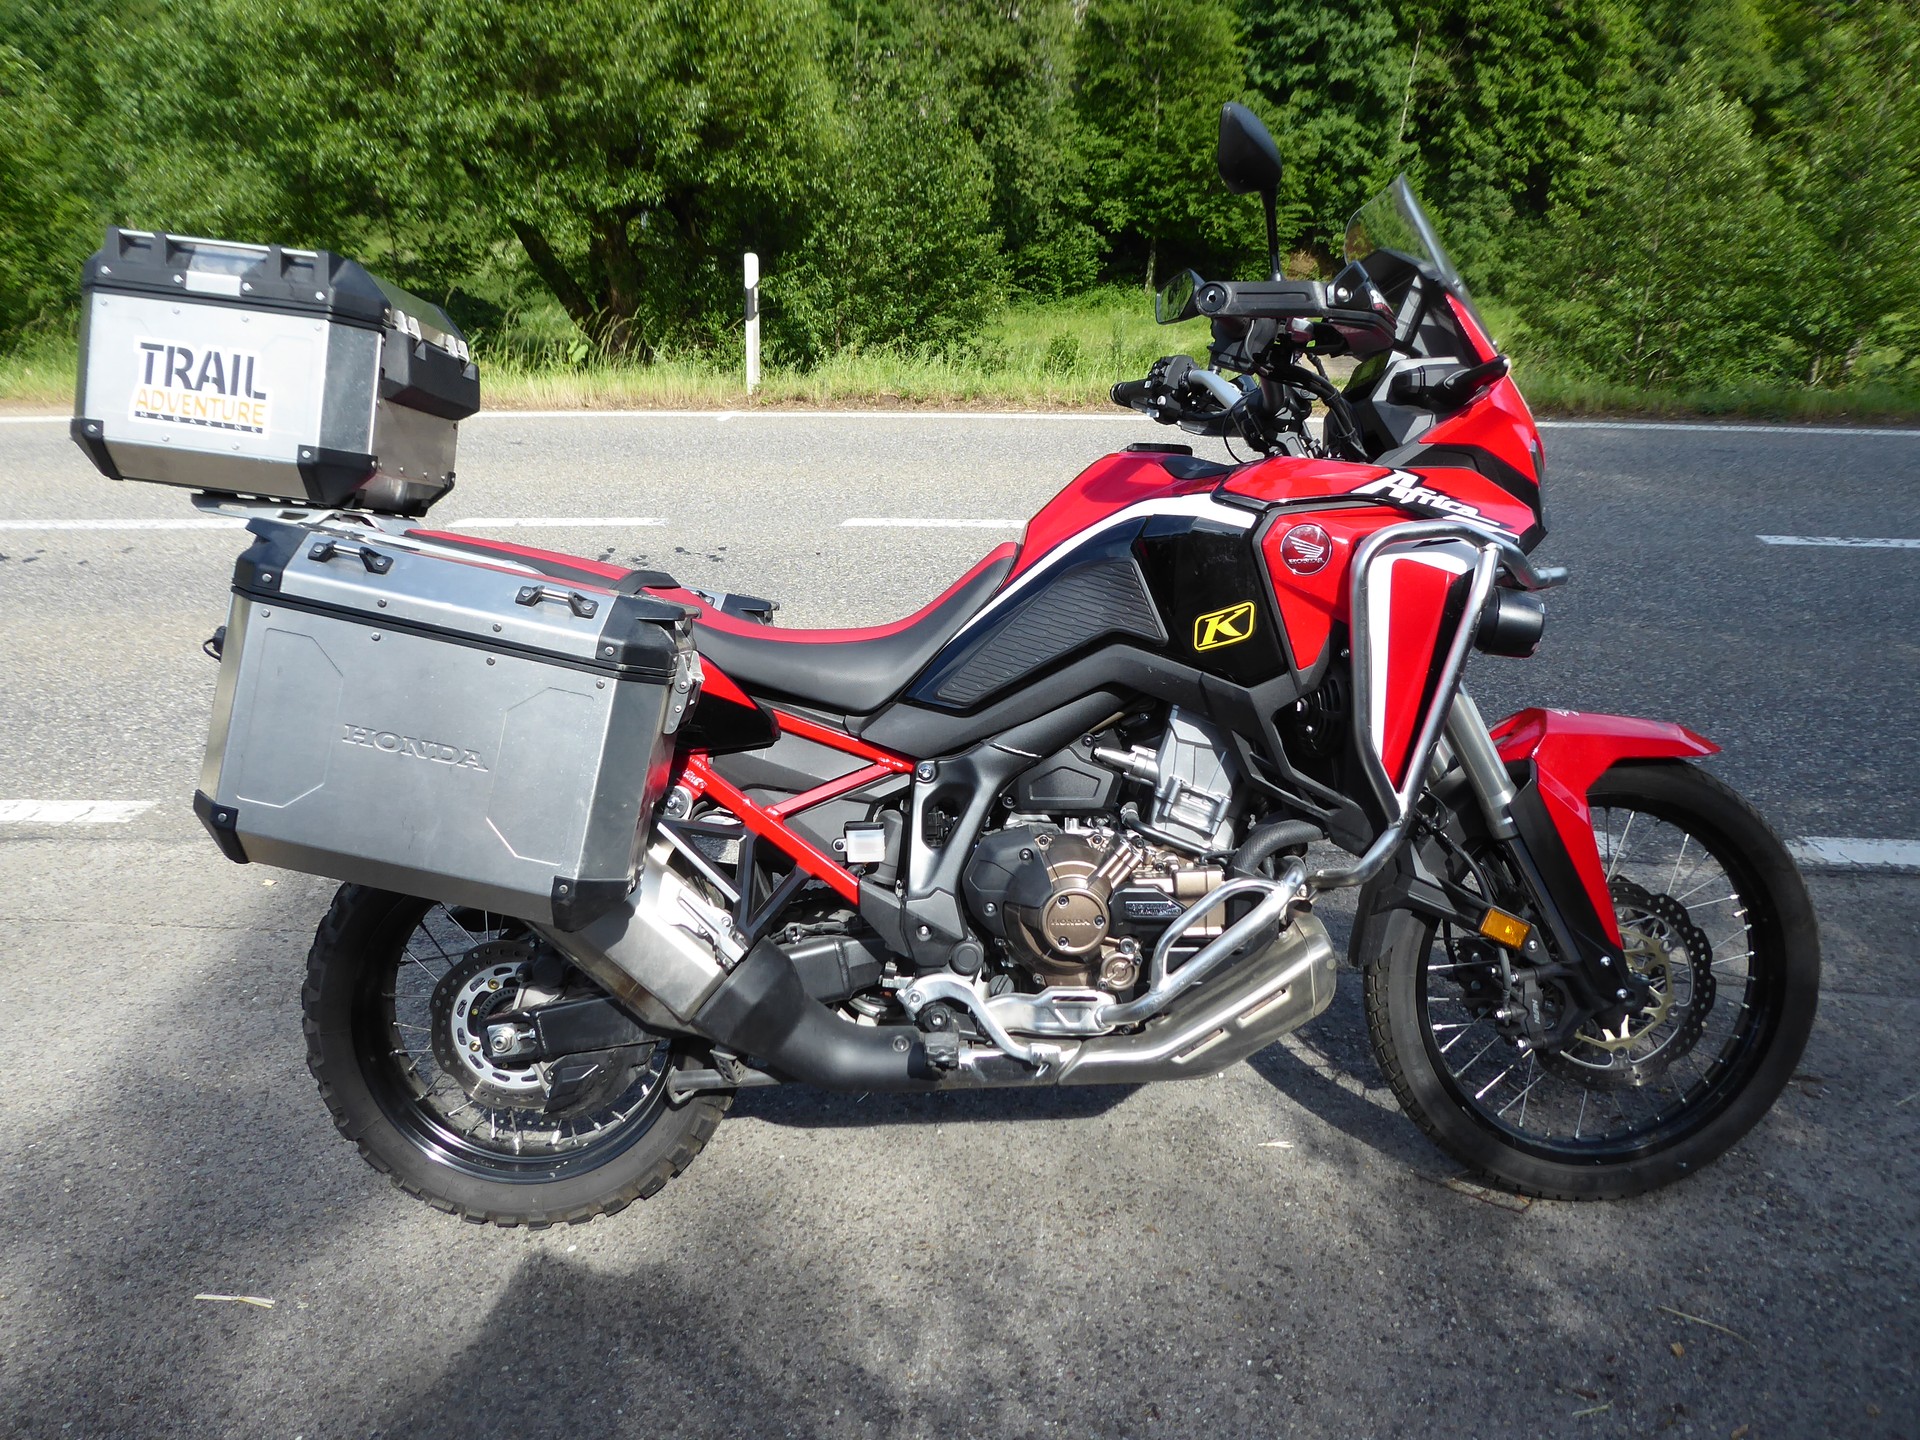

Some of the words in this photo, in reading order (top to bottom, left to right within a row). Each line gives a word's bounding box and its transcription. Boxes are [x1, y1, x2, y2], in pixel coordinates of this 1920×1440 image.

[140, 342, 266, 400] TRAIL
[136, 388, 266, 425] ADVENTURE
[1351, 469, 1480, 518] Africa
[342, 723, 489, 773] HONDA
